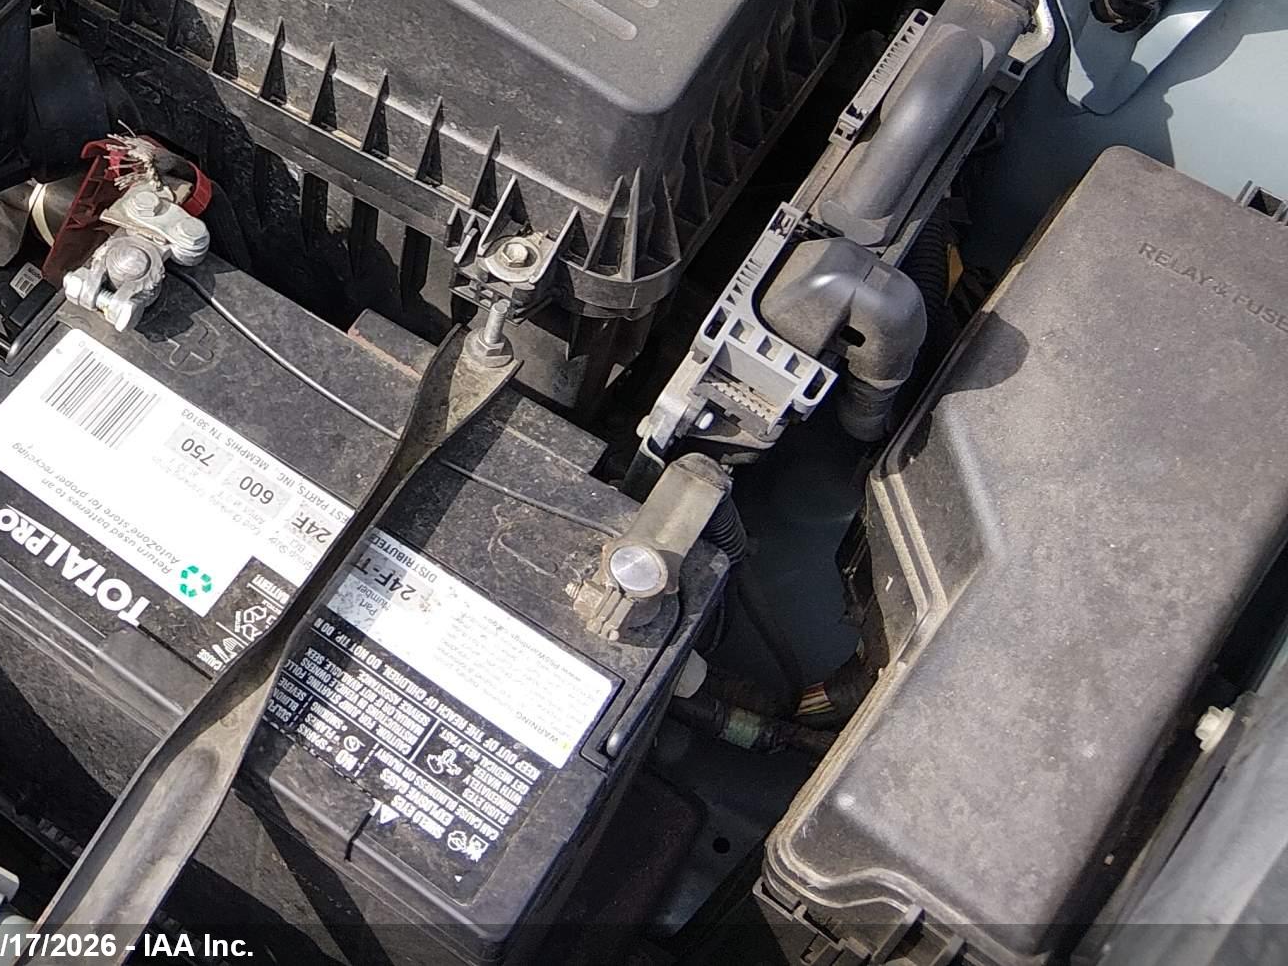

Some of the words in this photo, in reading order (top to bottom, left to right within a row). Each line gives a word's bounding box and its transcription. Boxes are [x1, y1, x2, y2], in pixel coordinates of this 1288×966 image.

[1138, 242, 1214, 286] RELAY
[179, 407, 210, 430] 38103
[178, 436, 217, 466] 750
[39, 477, 55, 489] an
[53, 472, 88, 498] proper
[53, 487, 66, 498] to
[236, 474, 276, 505] 600
[85, 496, 103, 510] for
[325, 505, 350, 524] EST
[101, 507, 130, 529] store
[290, 511, 333, 544] 24F
[108, 526, 137, 548] used
[133, 545, 173, 574] Return
[355, 582, 391, 611] Number
[357, 598, 378, 616] Part
[320, 620, 335, 636] DO
[333, 630, 351, 647] TIP.
[195, 648, 224, 670] CAUSE
[304, 646, 325, 664] SEEK
[348, 640, 370, 660] NOT
[365, 652, 383, 670] DO
[283, 658, 306, 679] FOLLO
[299, 656, 331, 683] OWNERS
[321, 658, 363, 691] AVAILABLE,
[277, 675, 307, 701] SEVERE
[303, 672, 342, 705] STARTING,
[328, 677, 359, 703] VEHICLE
[358, 685, 377, 702] NOT
[379, 663, 427, 701] CHILDREN.
[265, 698, 292, 722] SULFU
[270, 687, 299, 711] BLINDN
[337, 697, 361, 719] JUMP
[356, 697, 368, 709] IN
[374, 696, 384, 707] IF
[381, 701, 395, 715] OR
[422, 693, 439, 710] OF
[309, 700, 344, 730] SMOKING
[357, 711, 376, 730] FOR
[364, 703, 418, 745] INSTRUCTIONS
[391, 708, 424, 736] MANUAL
[398, 698, 431, 727] SERVICE
[435, 702, 468, 730] REACH
[295, 722, 329, 750] SPARKS
[303, 712, 336, 740] FLAMES
[436, 726, 461, 748] FAST.
[463, 722, 485, 743] THE
[457, 740, 481, 762] HELP
[482, 735, 500, 752] OF
[495, 744, 518, 766] OUT
[333, 747, 358, 771] NO
[373, 746, 405, 773] INJURY
[477, 754, 514, 785] MEDICAL
[513, 757, 540, 781] KEEP
[378, 766, 410, 795] GASES
[400, 765, 417, 782] OR
[412, 774, 458, 811] BLINDNESS
[460, 786, 485, 808] EYES
[462, 772, 517, 816] IMMEDIATELY
[498, 783, 523, 805] WITH
[510, 777, 529, 795] GET
[389, 793, 416, 818] EYES
[404, 785, 454, 826] EXPLOSIVE
[453, 803, 483, 830] CAUSE
[480, 800, 510, 826] FLUSH
[411, 809, 445, 839] SHIELD
[478, 821, 500, 841] CAN
